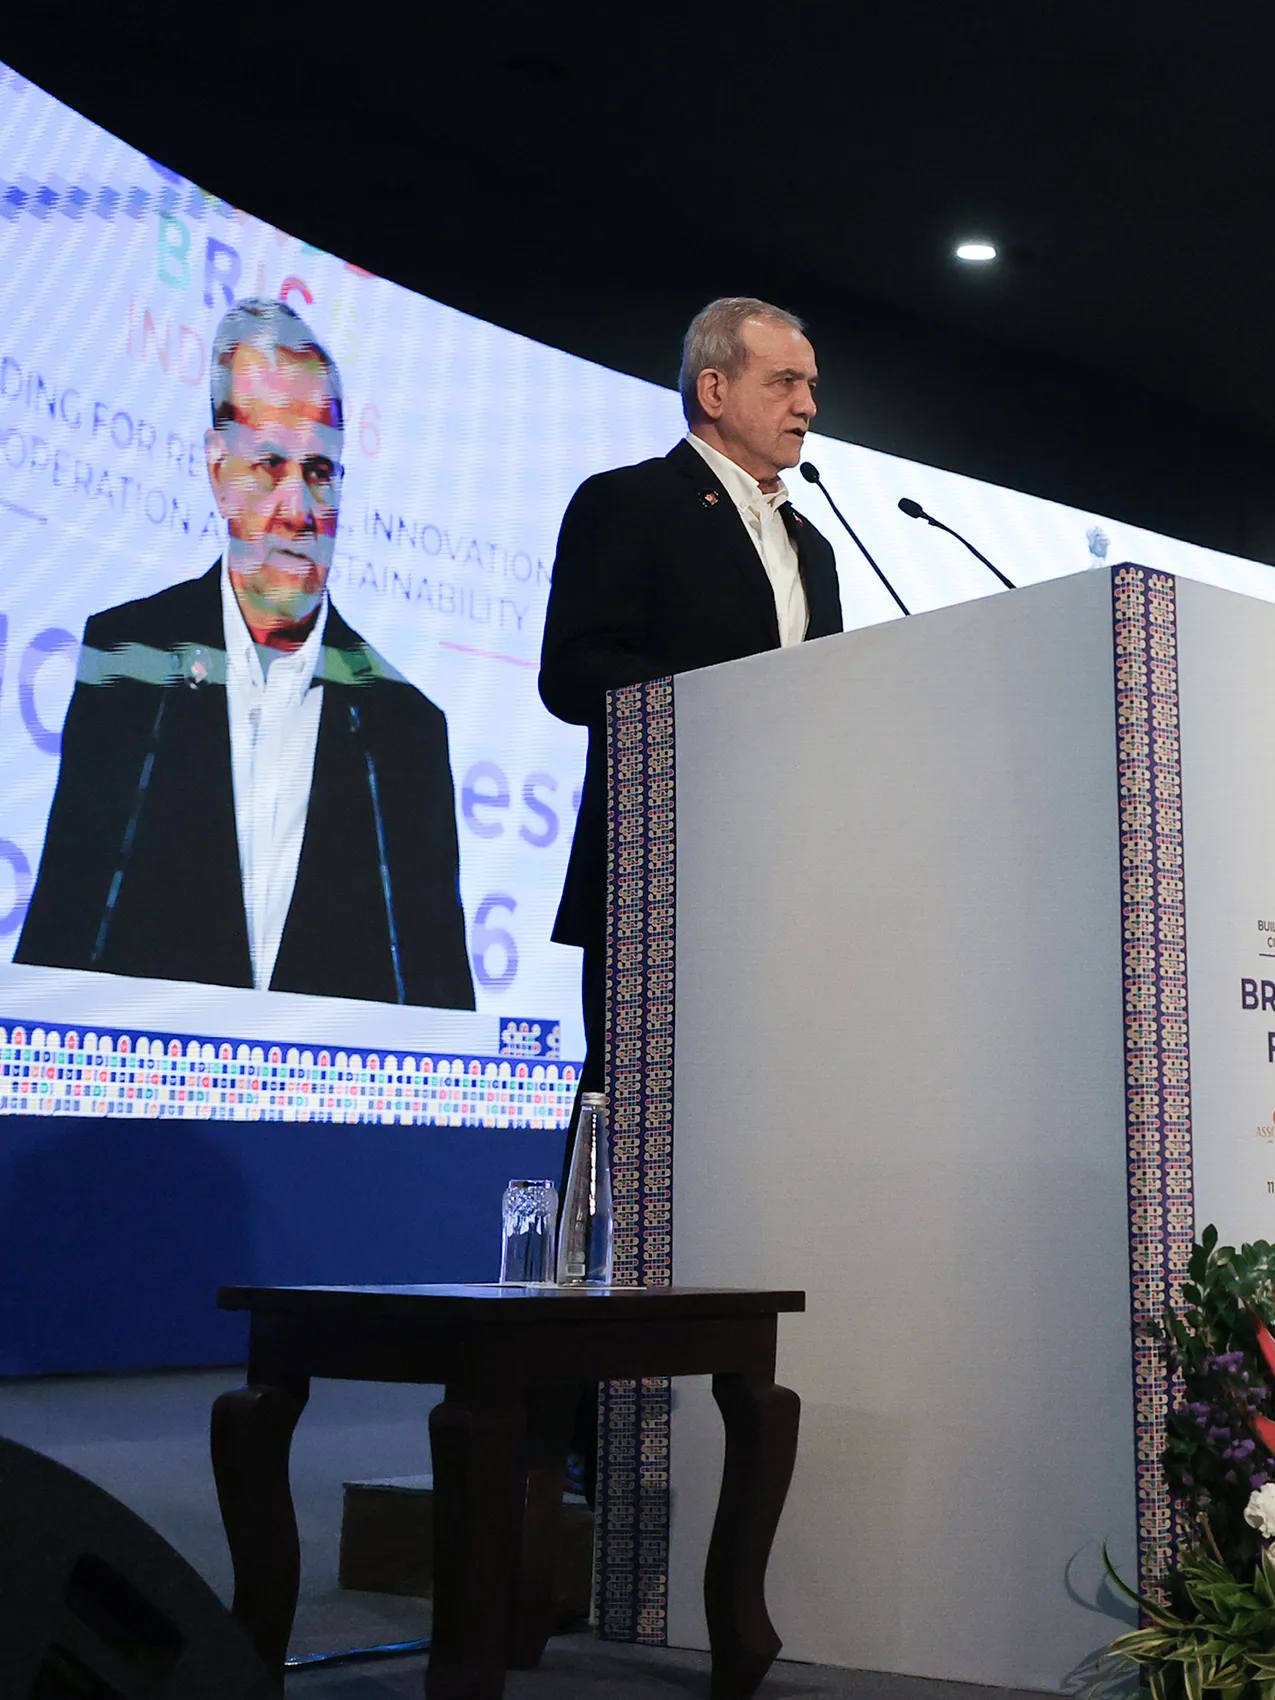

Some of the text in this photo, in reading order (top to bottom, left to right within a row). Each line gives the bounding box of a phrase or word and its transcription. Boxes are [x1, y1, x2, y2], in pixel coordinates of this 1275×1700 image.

[127, 300, 209, 386] IND
[0, 430, 191, 534] OPERATION
[1267, 1181, 1275, 1194] 11
